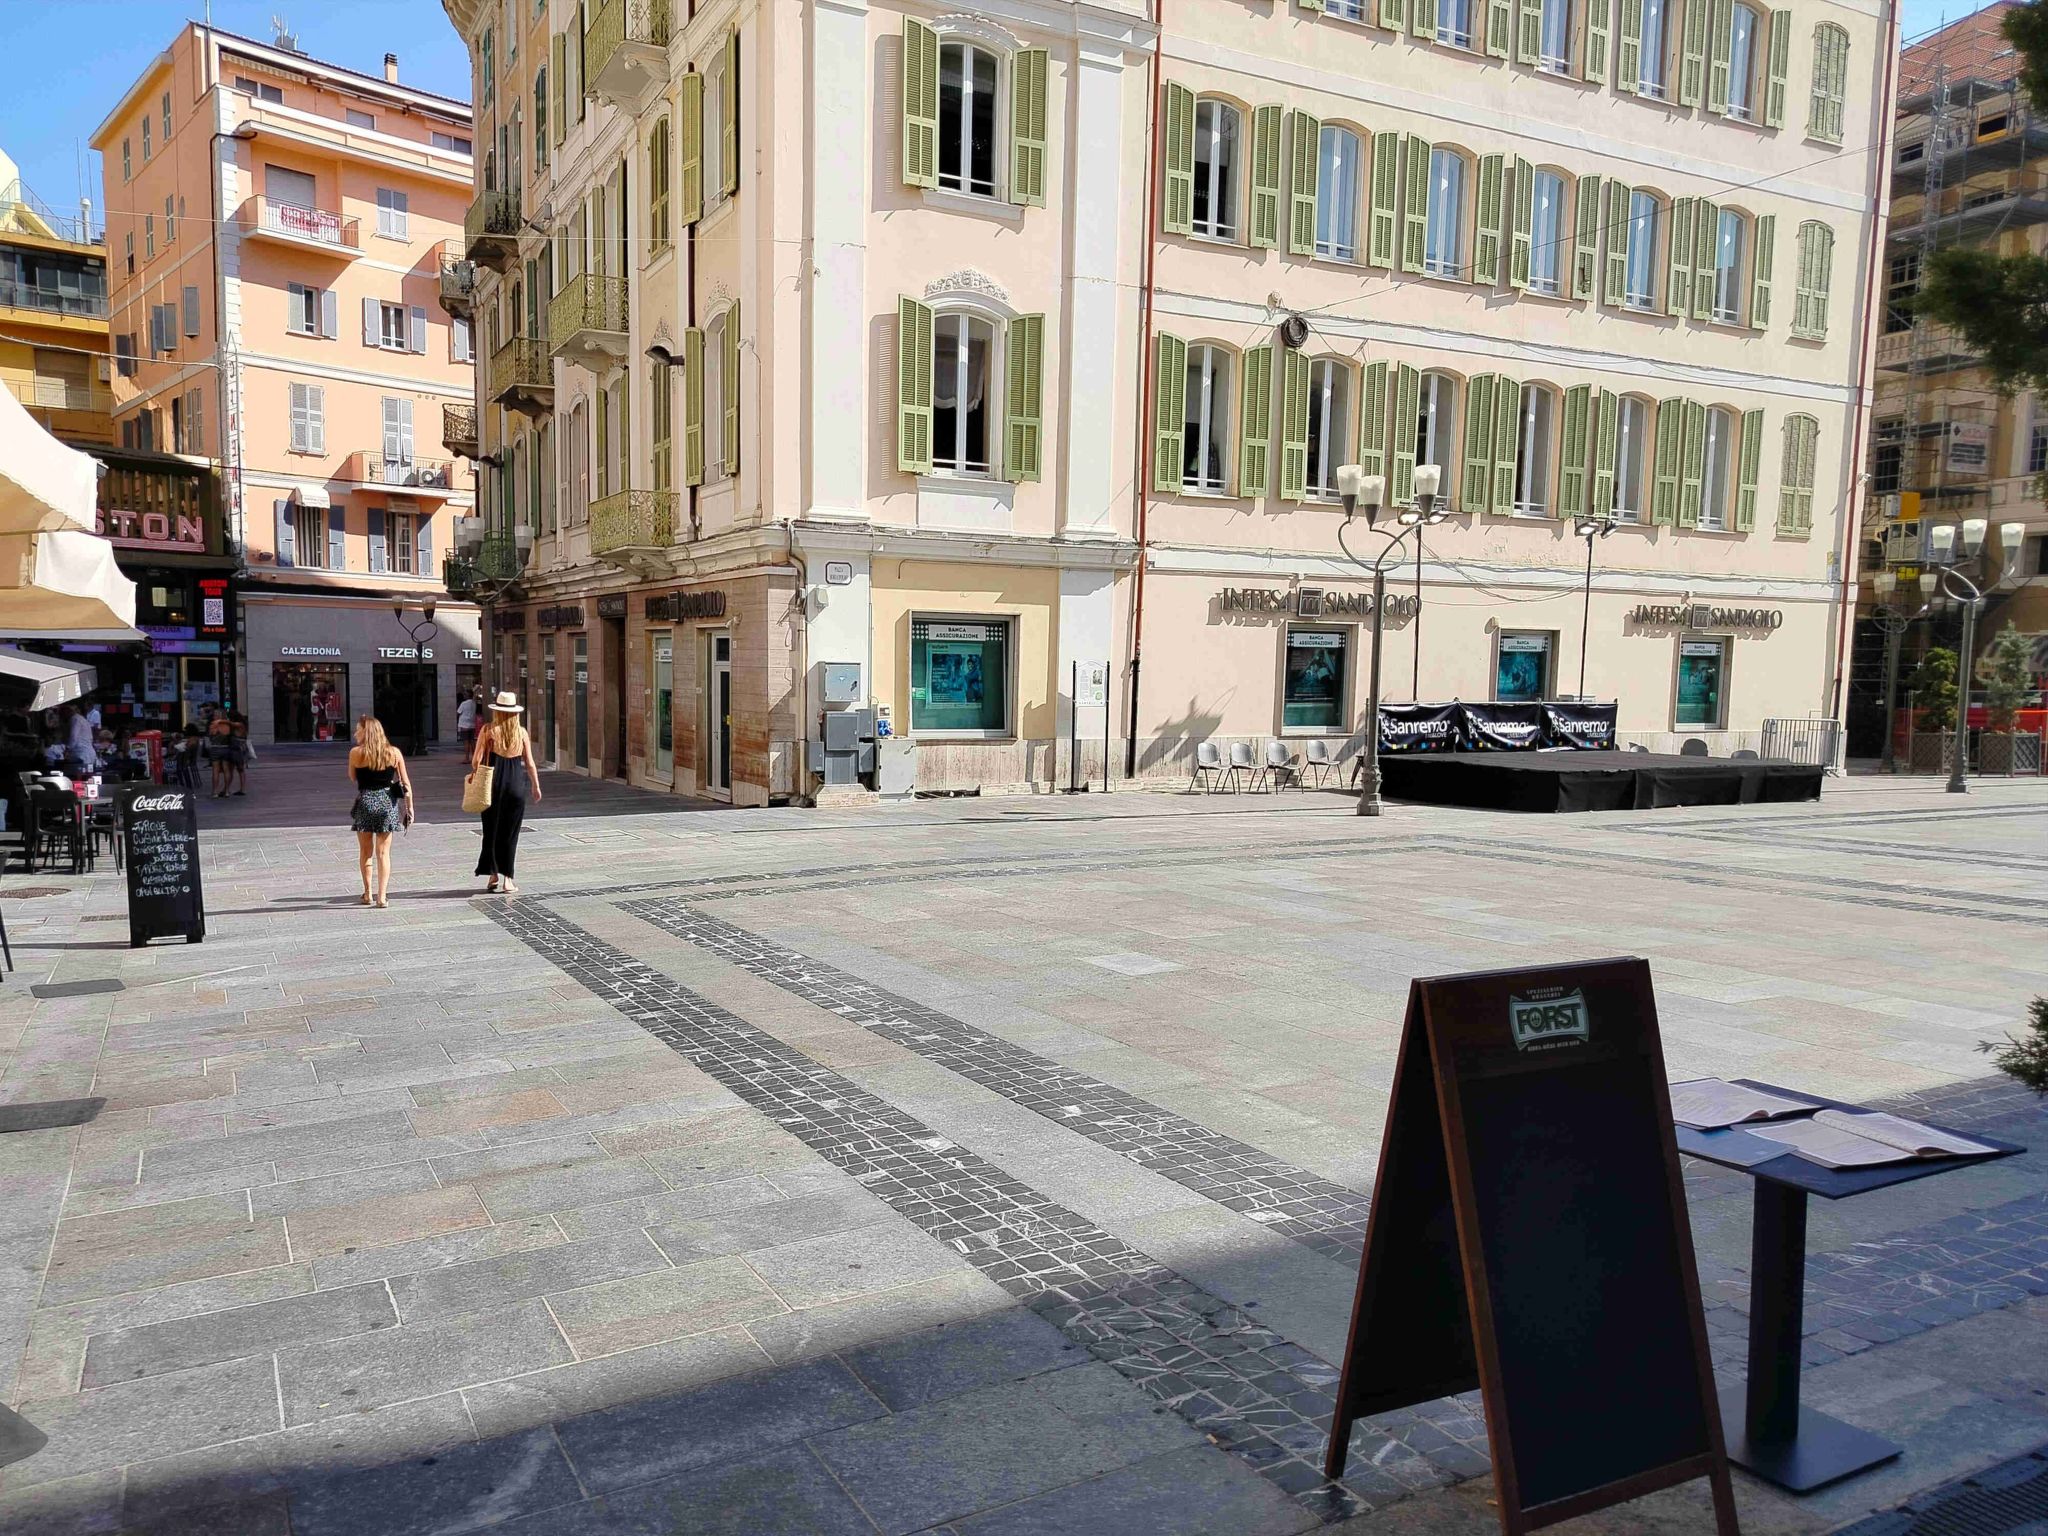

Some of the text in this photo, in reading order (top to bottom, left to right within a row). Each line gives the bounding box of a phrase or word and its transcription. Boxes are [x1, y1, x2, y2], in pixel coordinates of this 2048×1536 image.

[1222, 587, 1422, 617] INTESA SANPOLO
[1633, 604, 1689, 625] INTESA
[281, 647, 341, 656] CALZEDONIA
[378, 647, 434, 659] TEZENIS
[1390, 718, 1448, 734] Sanremo
[1477, 718, 1527, 734] Sanremo
[1558, 717, 1608, 733] Sanremo
[1516, 1003, 1582, 1034] FORST
